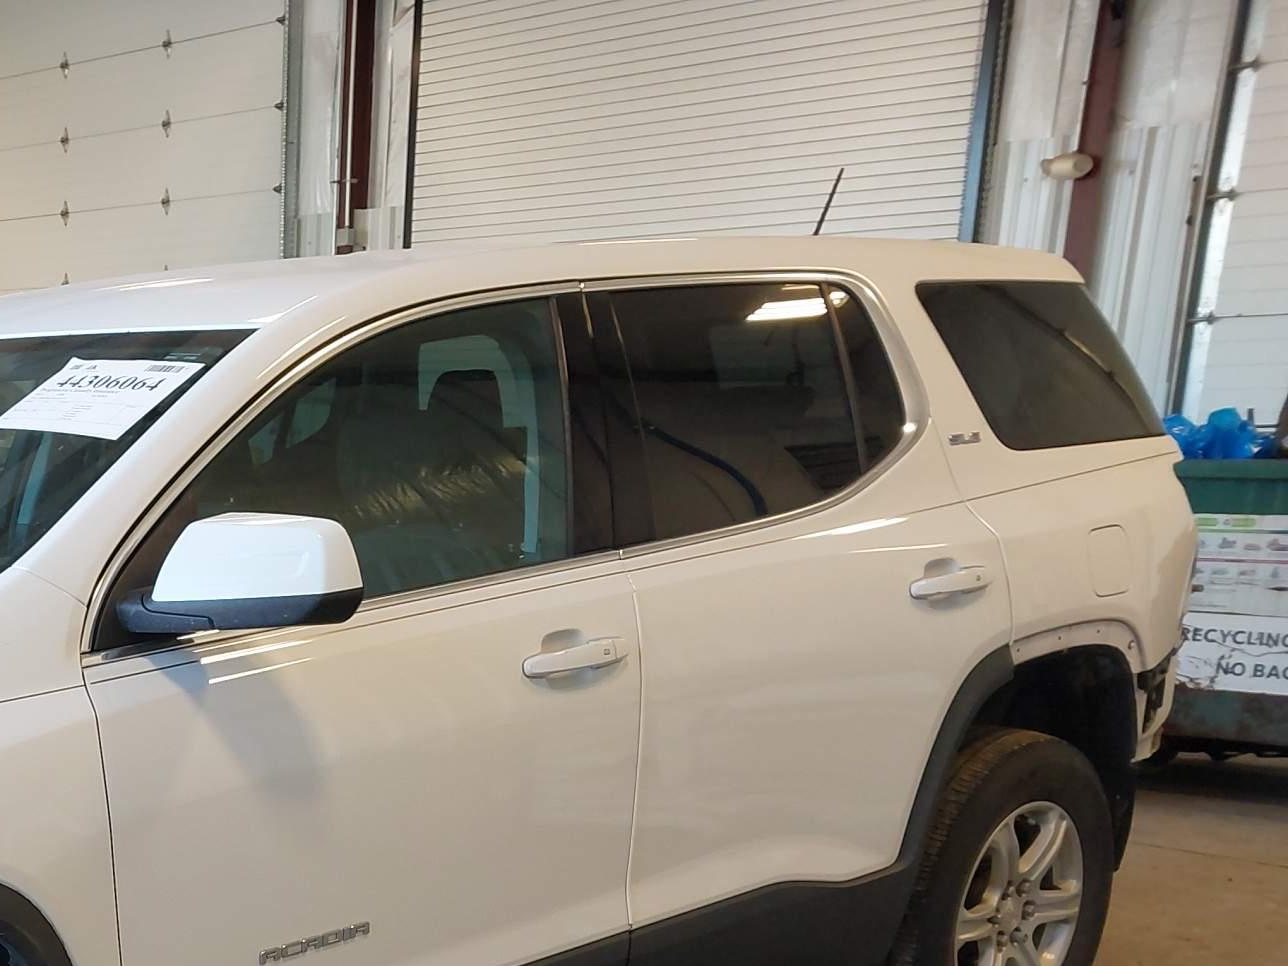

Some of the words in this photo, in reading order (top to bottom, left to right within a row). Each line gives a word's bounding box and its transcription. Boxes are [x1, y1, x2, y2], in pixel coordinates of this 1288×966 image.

[56, 375, 168, 392] 44306064
[1216, 660, 1246, 677] NO
[258, 920, 370, 966] ACADIA
